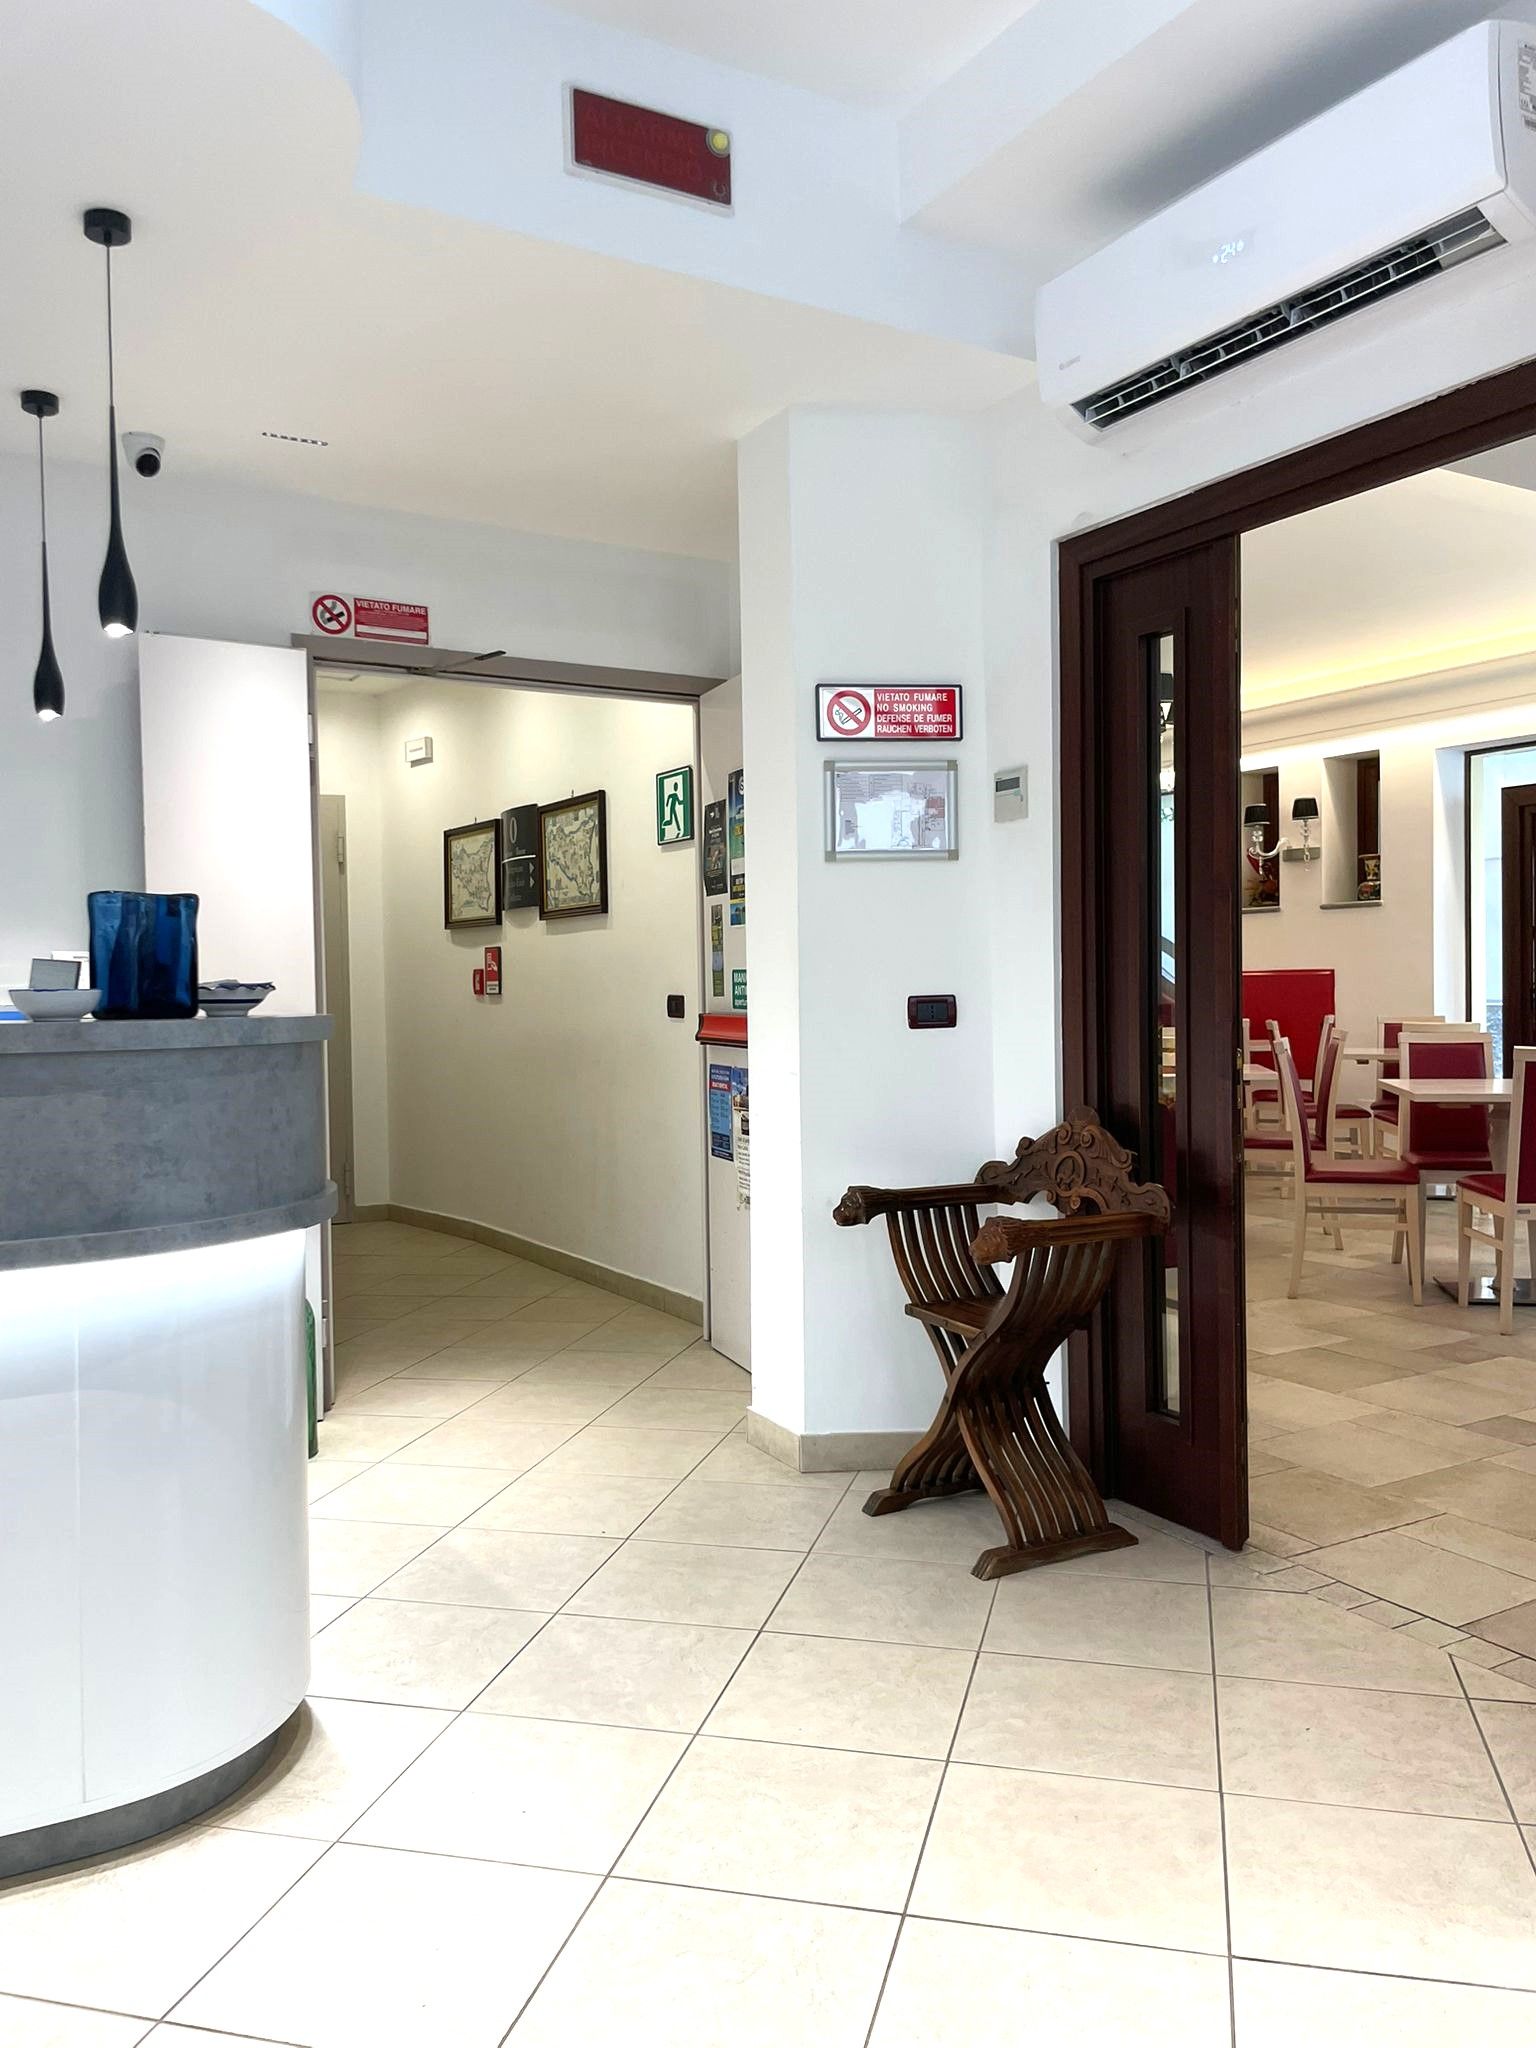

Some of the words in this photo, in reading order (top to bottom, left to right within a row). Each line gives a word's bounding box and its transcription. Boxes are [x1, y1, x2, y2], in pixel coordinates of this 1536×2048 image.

[355, 600, 391, 611] VIETATO
[392, 604, 426, 615] FUMARE
[877, 692, 910, 702] VIETATO
[913, 692, 948, 702] FUMARE
[877, 703, 890, 712] NO
[893, 703, 933, 712] SMOKING
[877, 713, 912, 723] DEFENSE
[913, 714, 924, 723] DE
[926, 713, 953, 723] FUMER
[877, 724, 912, 734] RAUCHEN
[914, 724, 953, 734] VERBOTEN
